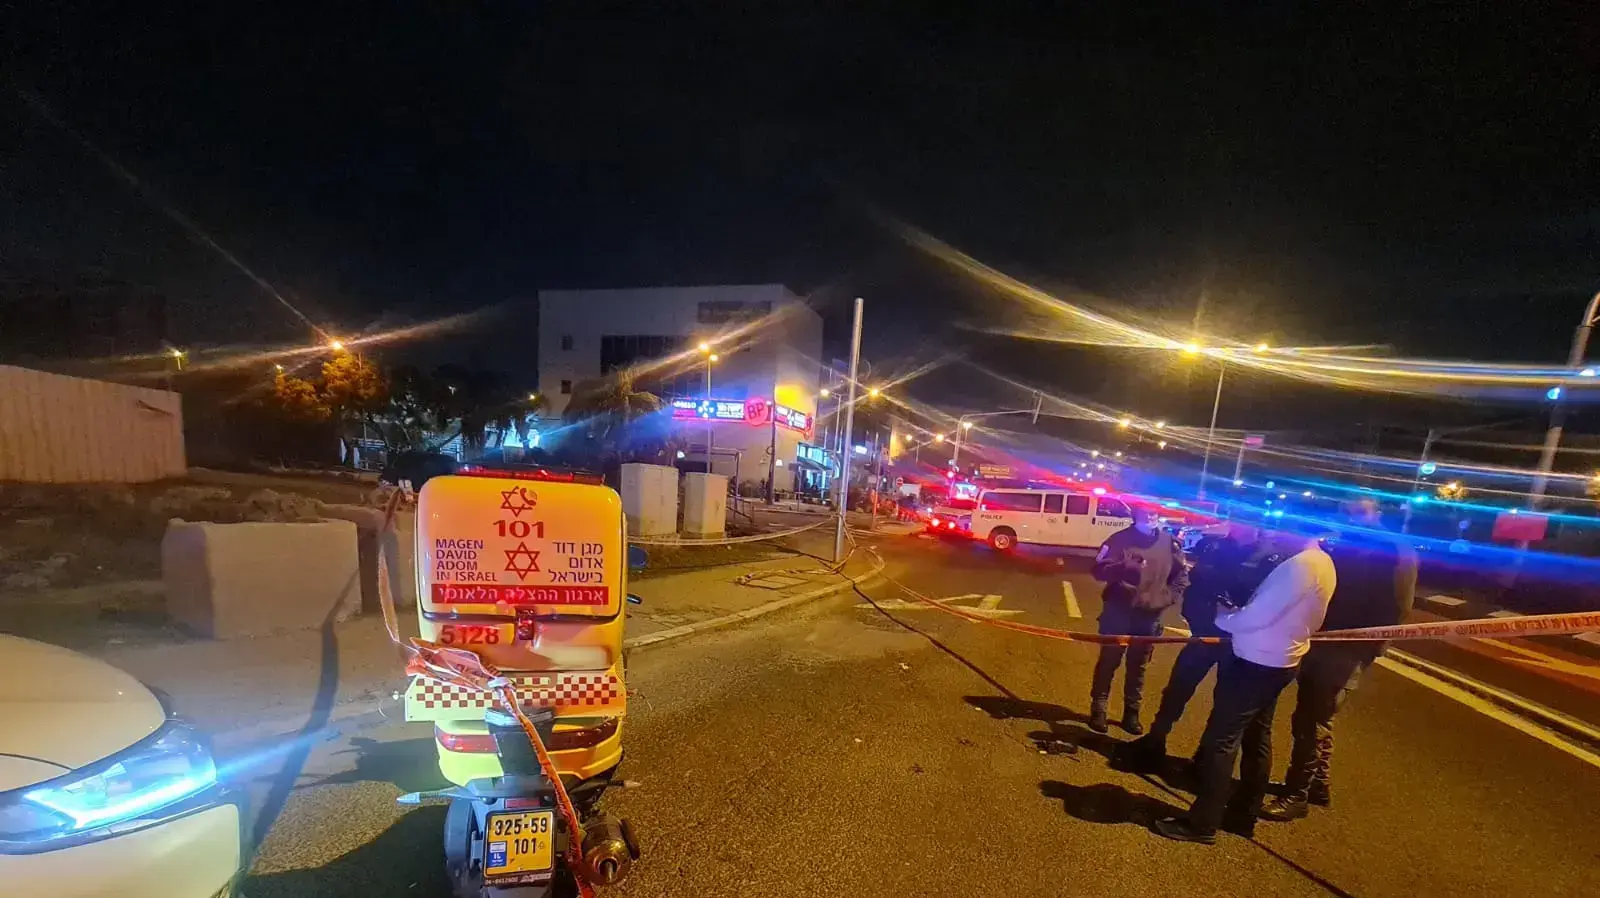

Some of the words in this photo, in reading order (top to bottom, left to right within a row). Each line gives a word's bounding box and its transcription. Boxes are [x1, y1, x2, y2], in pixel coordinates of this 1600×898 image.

[493, 520, 544, 539] 101
[435, 539, 483, 550] MAGEN
[552, 541, 575, 554] דוד
[580, 543, 603, 556] מגן
[436, 550, 477, 560] DAVID
[436, 560, 478, 571] ADOM
[569, 557, 603, 569] אדום
[436, 571, 450, 581] IN
[455, 572, 498, 582] ISRAEL
[549, 569, 603, 583] בישראל
[439, 586, 498, 600] הלאומי
[504, 588, 558, 601] ההצלה
[564, 589, 603, 603] ארגון
[441, 624, 498, 645] 5128
[495, 817, 547, 836] 325-59
[514, 837, 536, 855] 101
